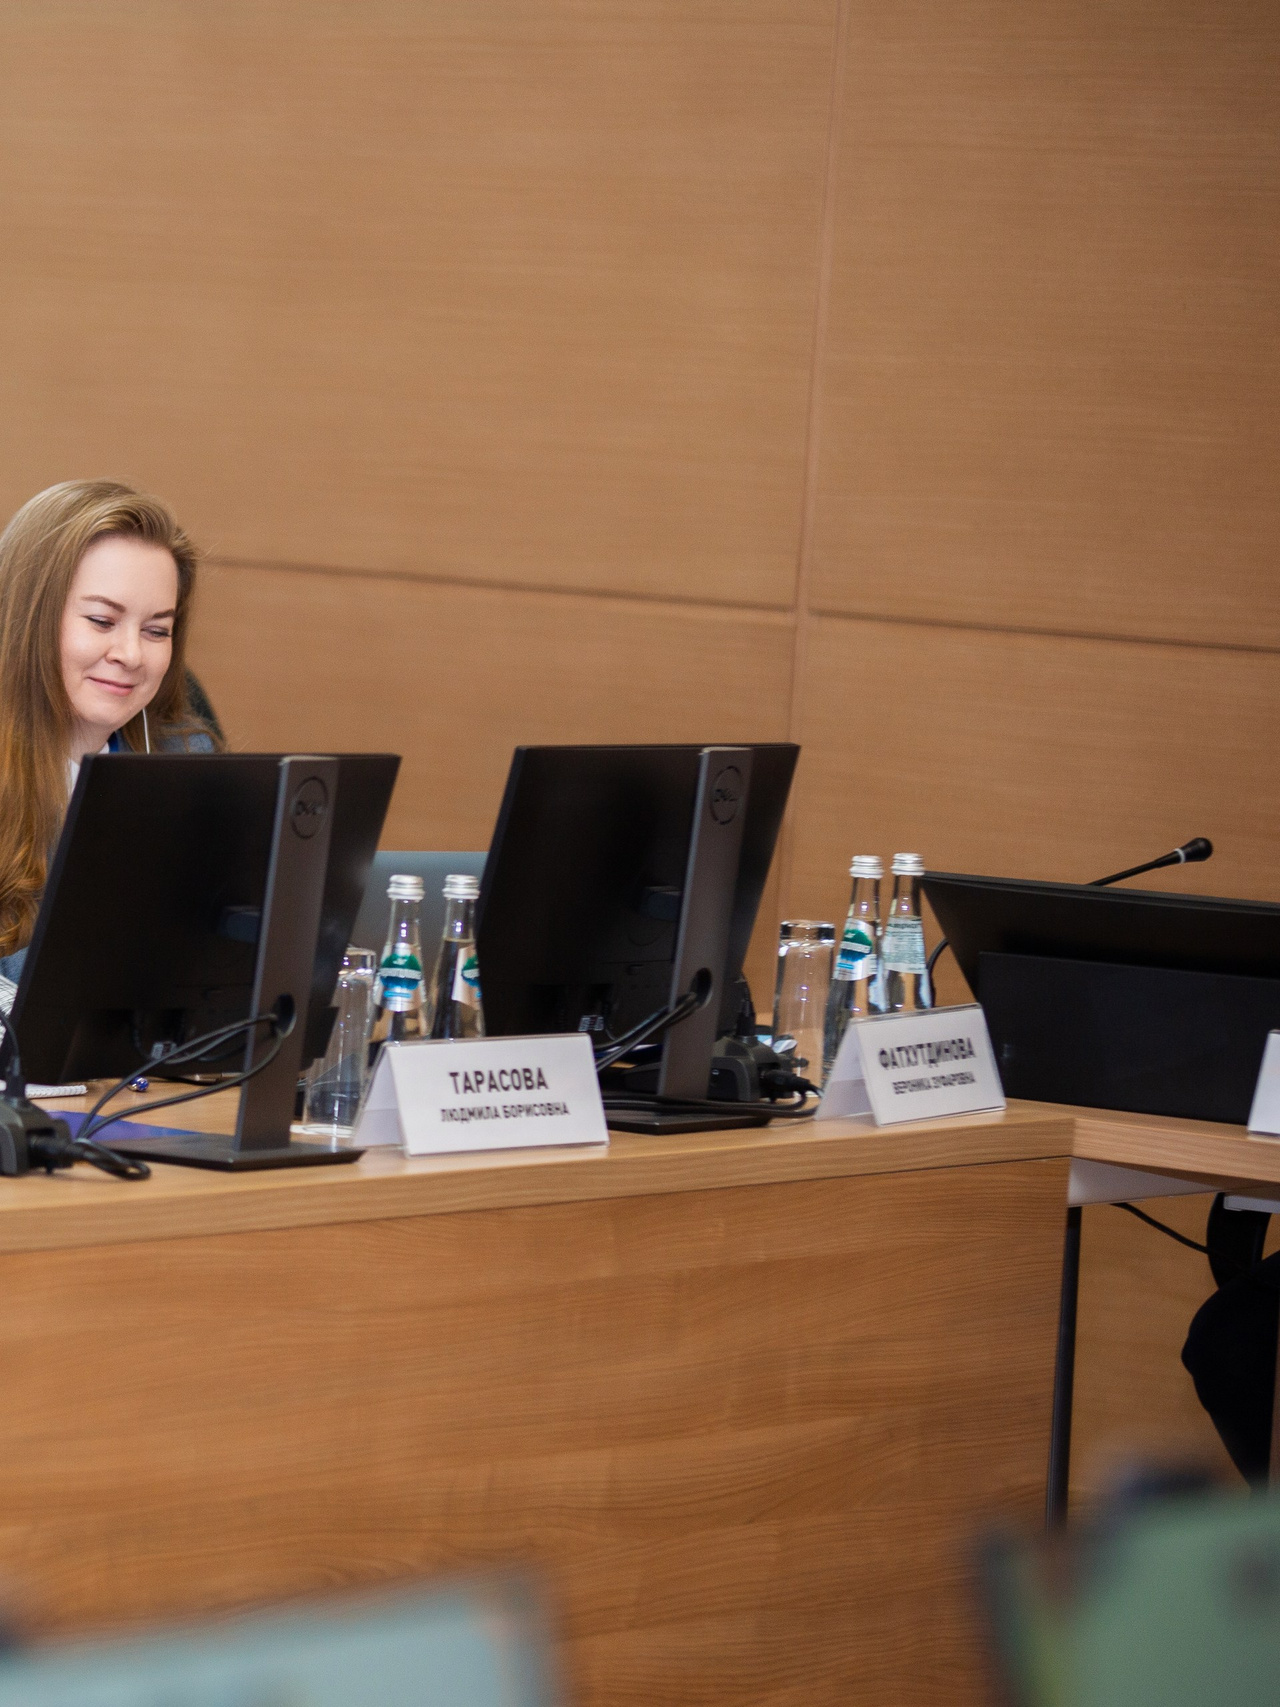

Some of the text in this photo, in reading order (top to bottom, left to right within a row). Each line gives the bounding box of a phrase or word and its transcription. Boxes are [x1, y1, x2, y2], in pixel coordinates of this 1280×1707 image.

[878, 1037, 977, 1070] ФАТХУТДИНОВА
[449, 1067, 549, 1094] ТАРАСОВА
[440, 1101, 570, 1124] ЛЮДМИЛА БОРИСОВНА
